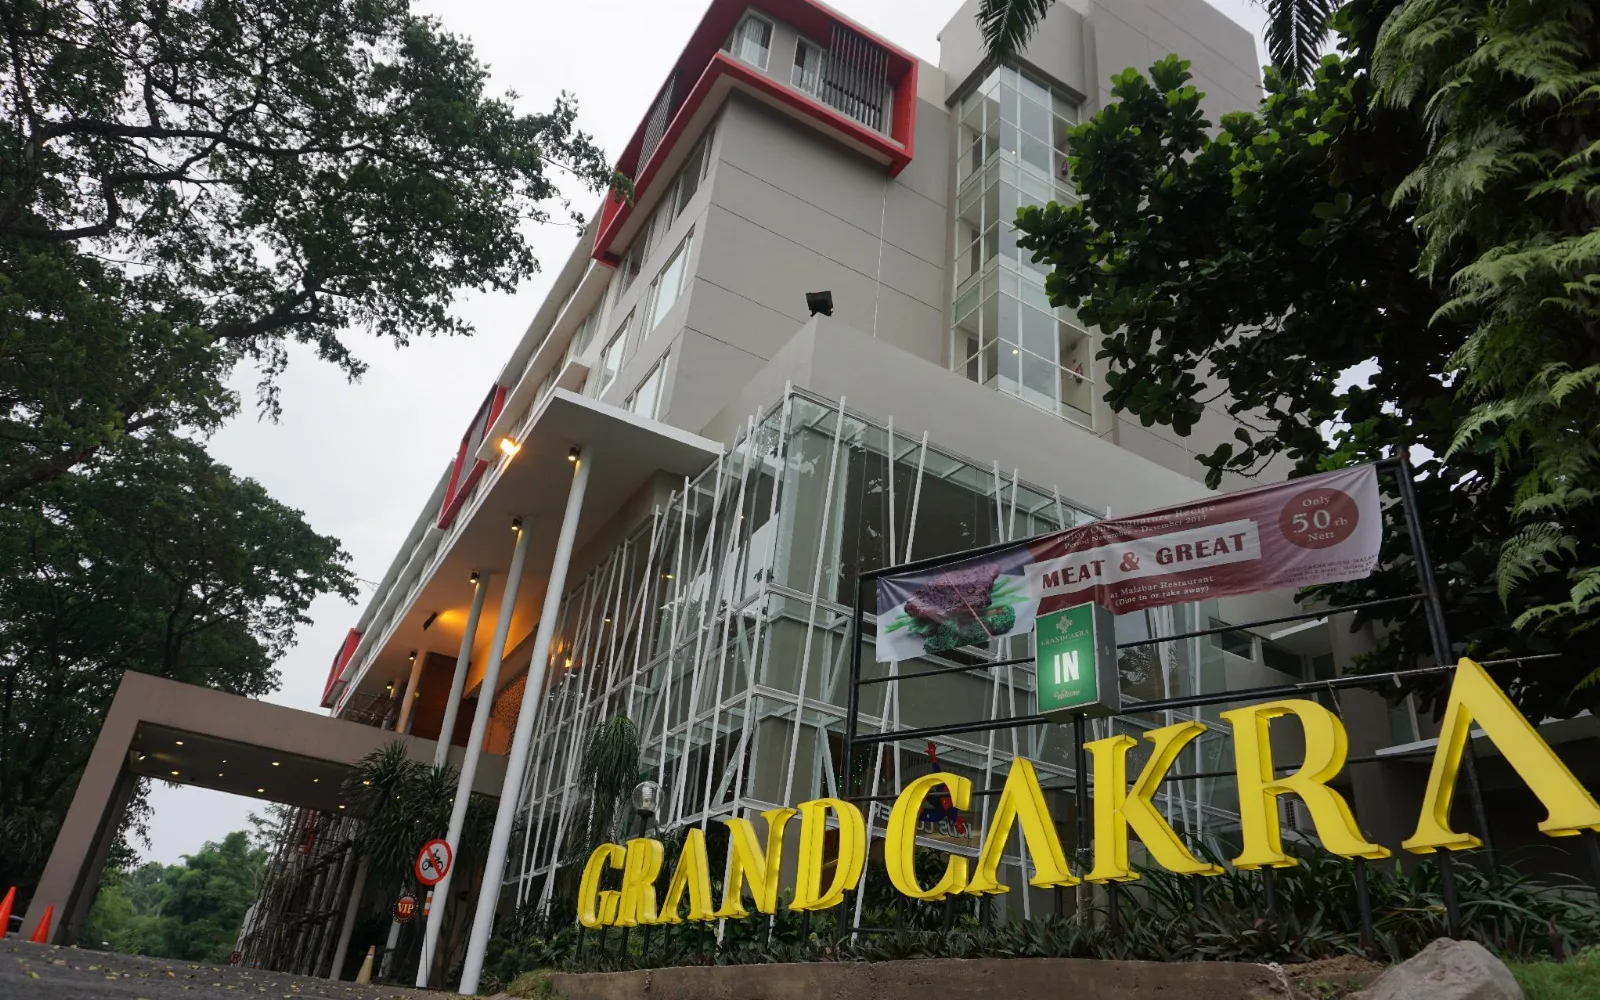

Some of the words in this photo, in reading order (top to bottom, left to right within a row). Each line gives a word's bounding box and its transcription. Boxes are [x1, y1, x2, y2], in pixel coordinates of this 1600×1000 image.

[1175, 504, 1216, 518] Recipe
[1302, 496, 1331, 507] Only
[1064, 537, 1090, 550] Period
[1091, 527, 1133, 542] November
[1185, 514, 1208, 525] 2017
[1292, 509, 1331, 534] 50
[1334, 517, 1348, 527] rb
[1308, 531, 1335, 542] Nett
[1042, 559, 1105, 590] MEAT
[1119, 551, 1140, 573] &
[1155, 532, 1247, 566] GREAT
[1114, 595, 1137, 608] (Dine
[1138, 593, 1148, 601] in
[1162, 588, 1181, 598] take
[1183, 585, 1210, 595] away)
[1120, 584, 1157, 596] Malabar
[1160, 575, 1215, 589] Restaurant
[1054, 650, 1080, 685] IN
[577, 797, 867, 929] GRAND
[884, 657, 1600, 900] CAKRA
[398, 902, 415, 914] VIP
